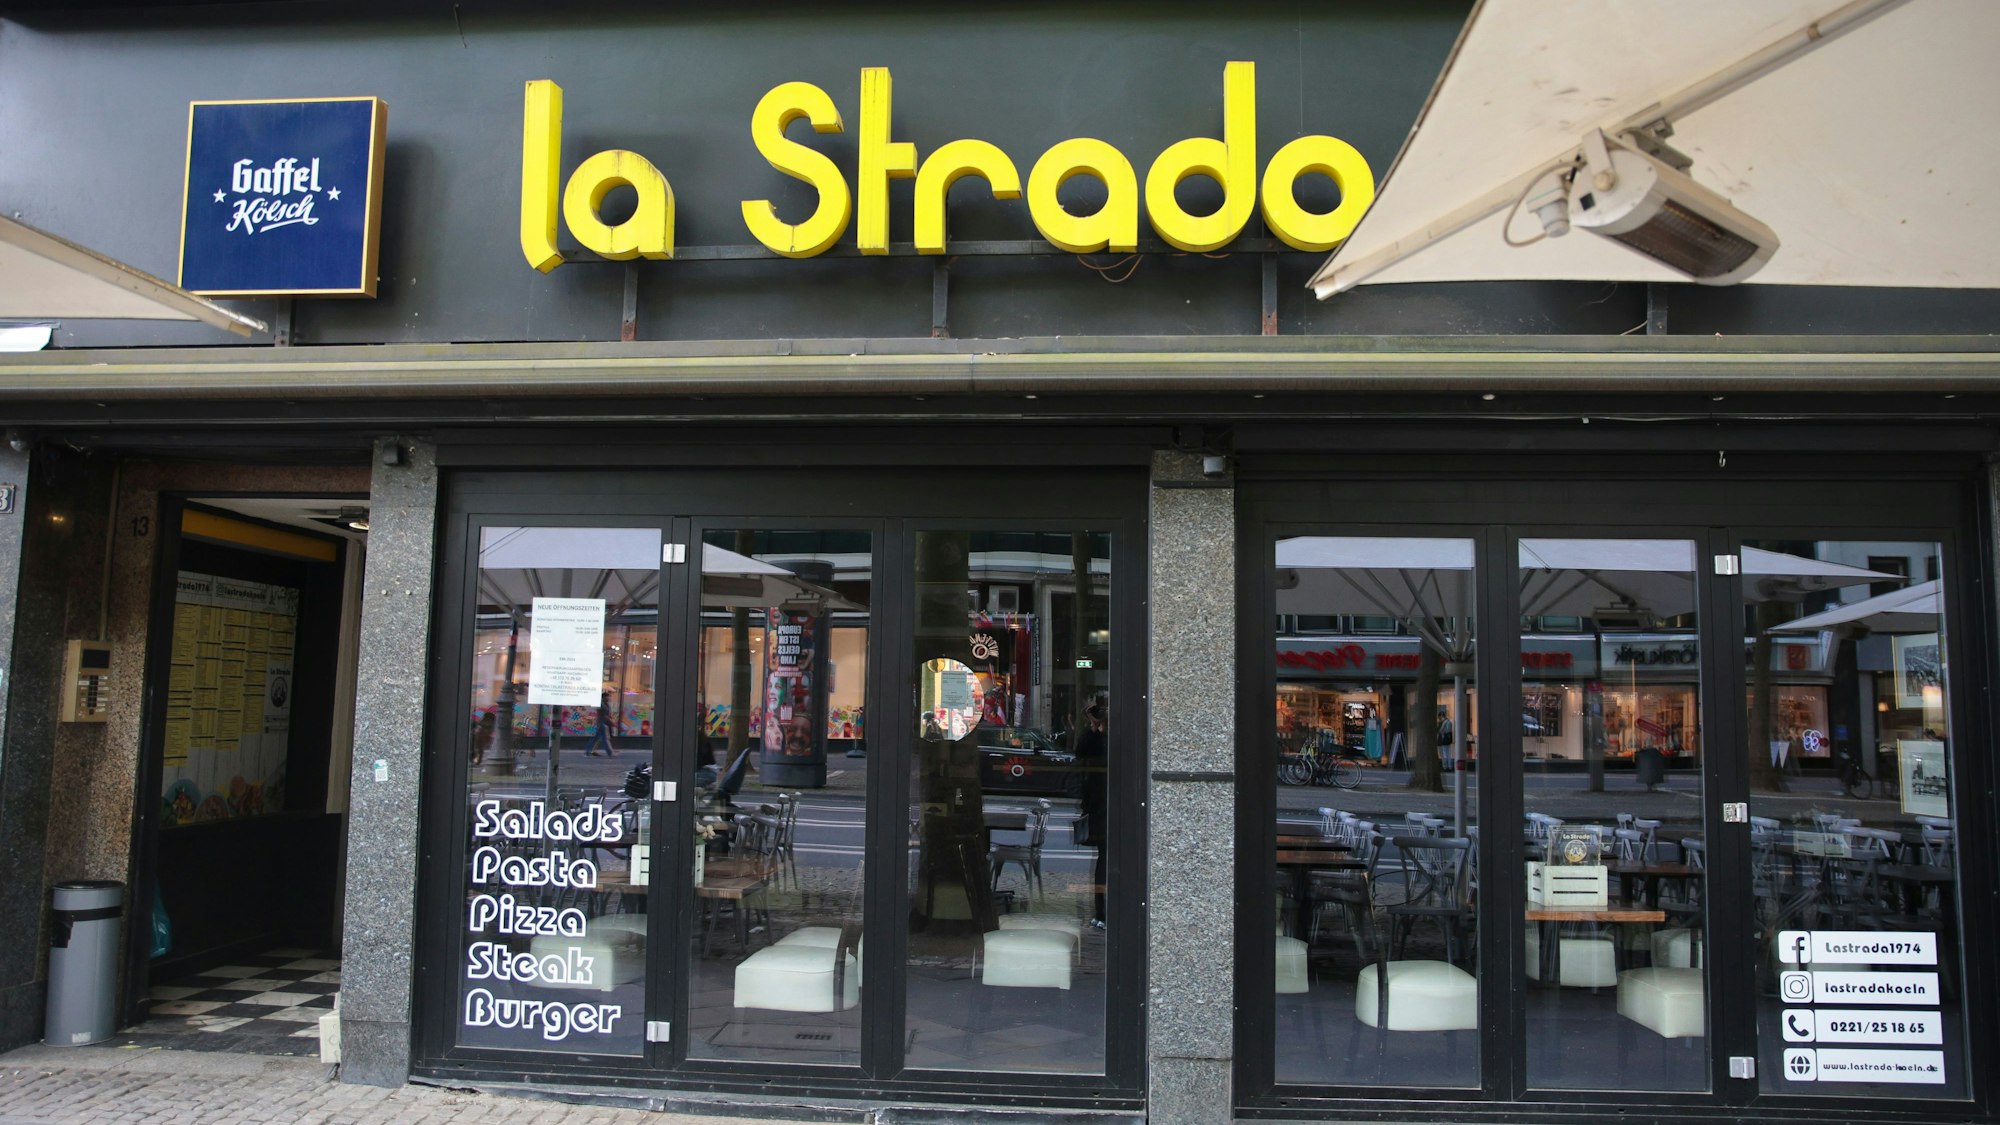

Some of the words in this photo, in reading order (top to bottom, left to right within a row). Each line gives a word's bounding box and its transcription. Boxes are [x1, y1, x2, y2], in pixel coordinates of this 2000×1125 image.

[232, 157, 322, 196] Gaffel
[225, 194, 320, 235] Kölsch
[131, 516, 150, 537] 13
[474, 800, 623, 842] Salads
[472, 846, 598, 889] Pasta
[469, 893, 587, 937] Pizza
[467, 941, 595, 985] Steak
[1825, 942, 1922, 954] Lastrada1974
[465, 988, 622, 1042] Burger
[1891, 1022, 1905, 1033] 18
[1909, 1022, 1925, 1034] 65
